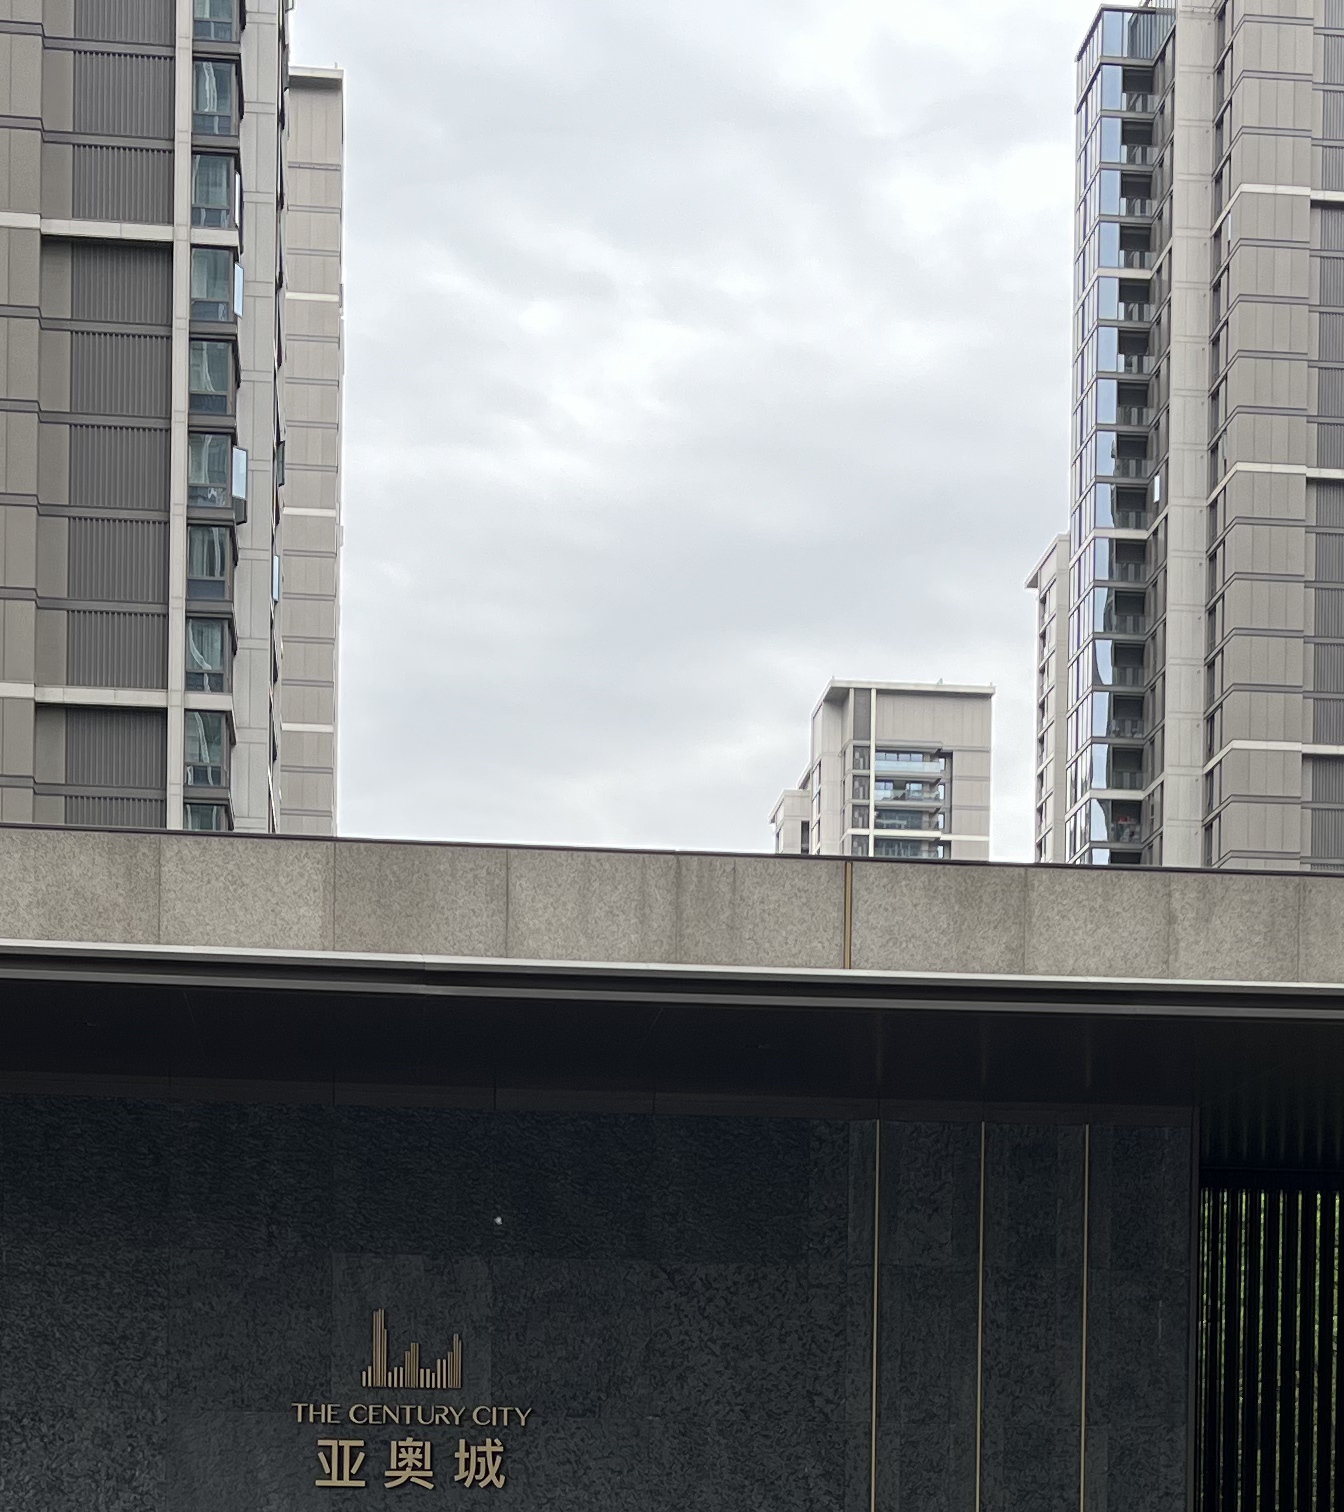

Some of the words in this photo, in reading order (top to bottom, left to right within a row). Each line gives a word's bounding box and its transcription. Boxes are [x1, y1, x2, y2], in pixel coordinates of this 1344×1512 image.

[291, 1403, 341, 1424] THE
[348, 1404, 465, 1425] CENTURY
[472, 1405, 532, 1426] CITY
[315, 1437, 505, 1489] 亚奥城
